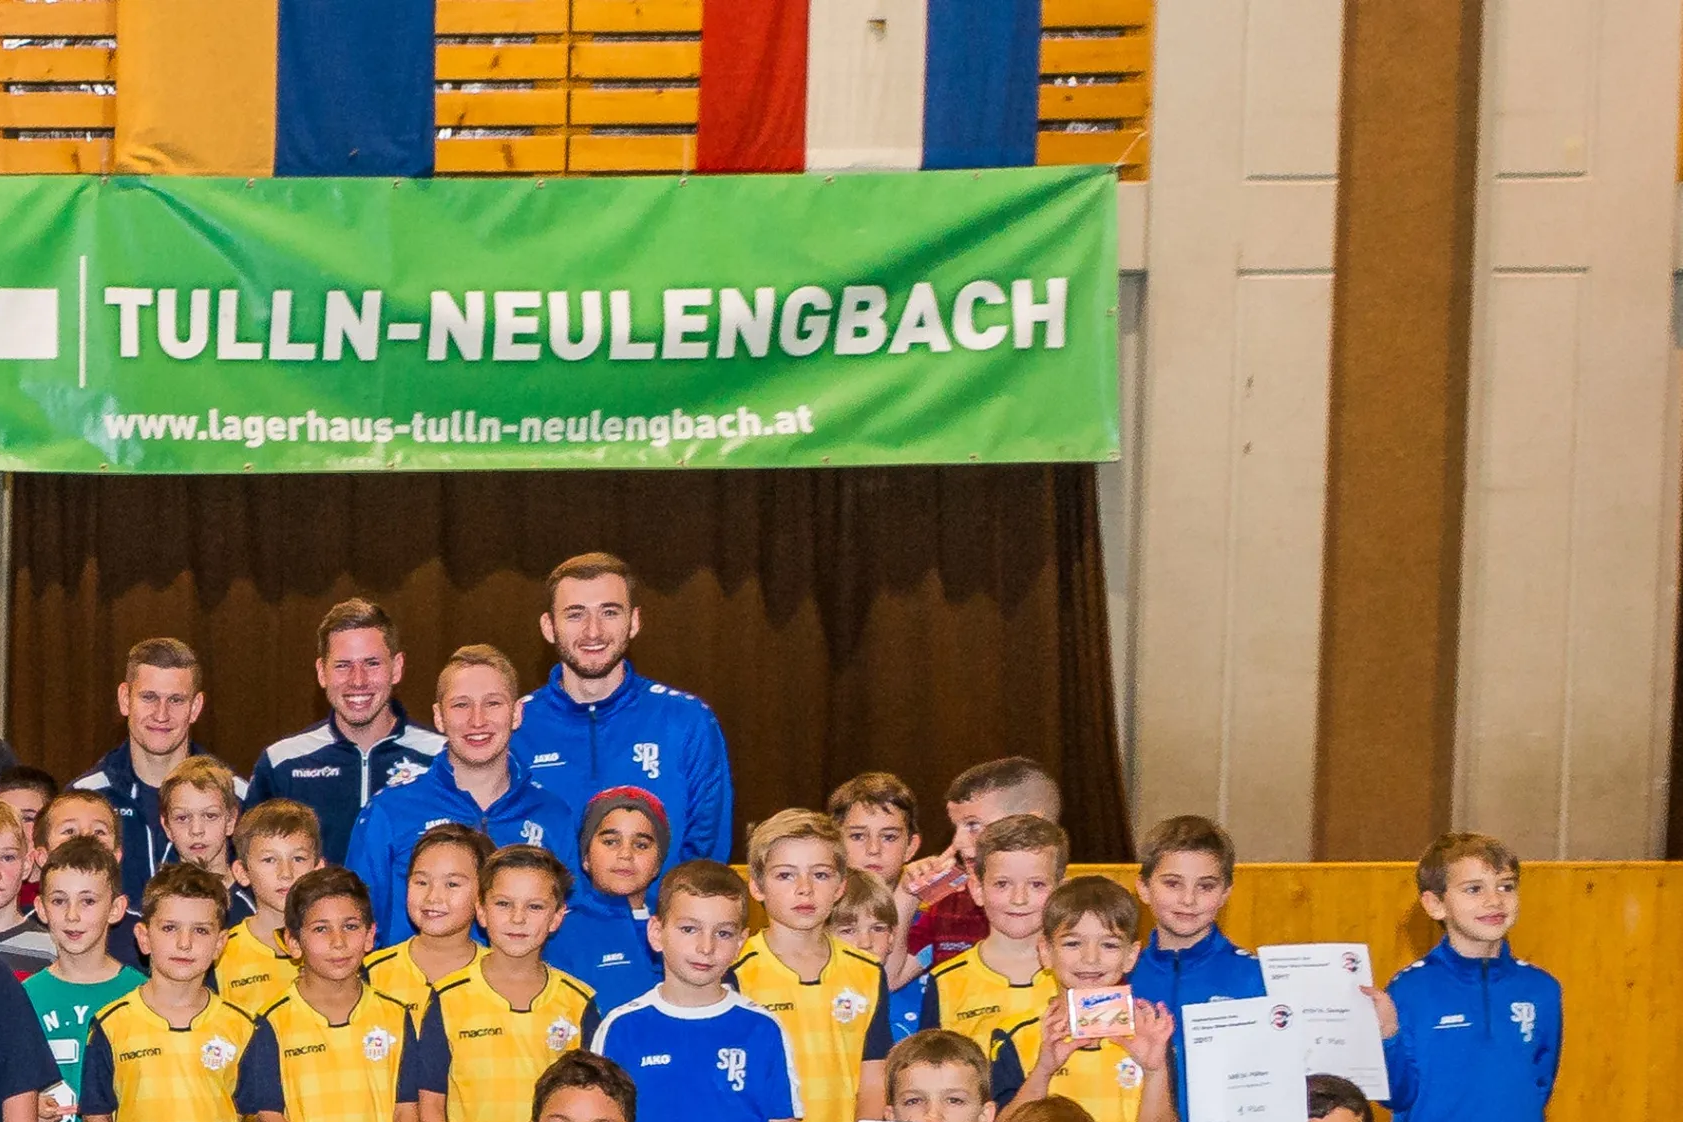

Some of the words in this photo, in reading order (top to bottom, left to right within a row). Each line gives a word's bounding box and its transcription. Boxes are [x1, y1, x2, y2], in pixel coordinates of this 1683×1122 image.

[104, 277, 1068, 361] TULLN-NEULENGBACH
[104, 404, 814, 448] www.lagerhaus-tulln-neulengbach.at
[292, 766, 340, 778] macron
[230, 973, 270, 989] macron
[956, 1005, 1001, 1021] macron
[459, 1027, 503, 1040] macron
[119, 1047, 162, 1062] macron
[284, 1043, 327, 1059] macron
